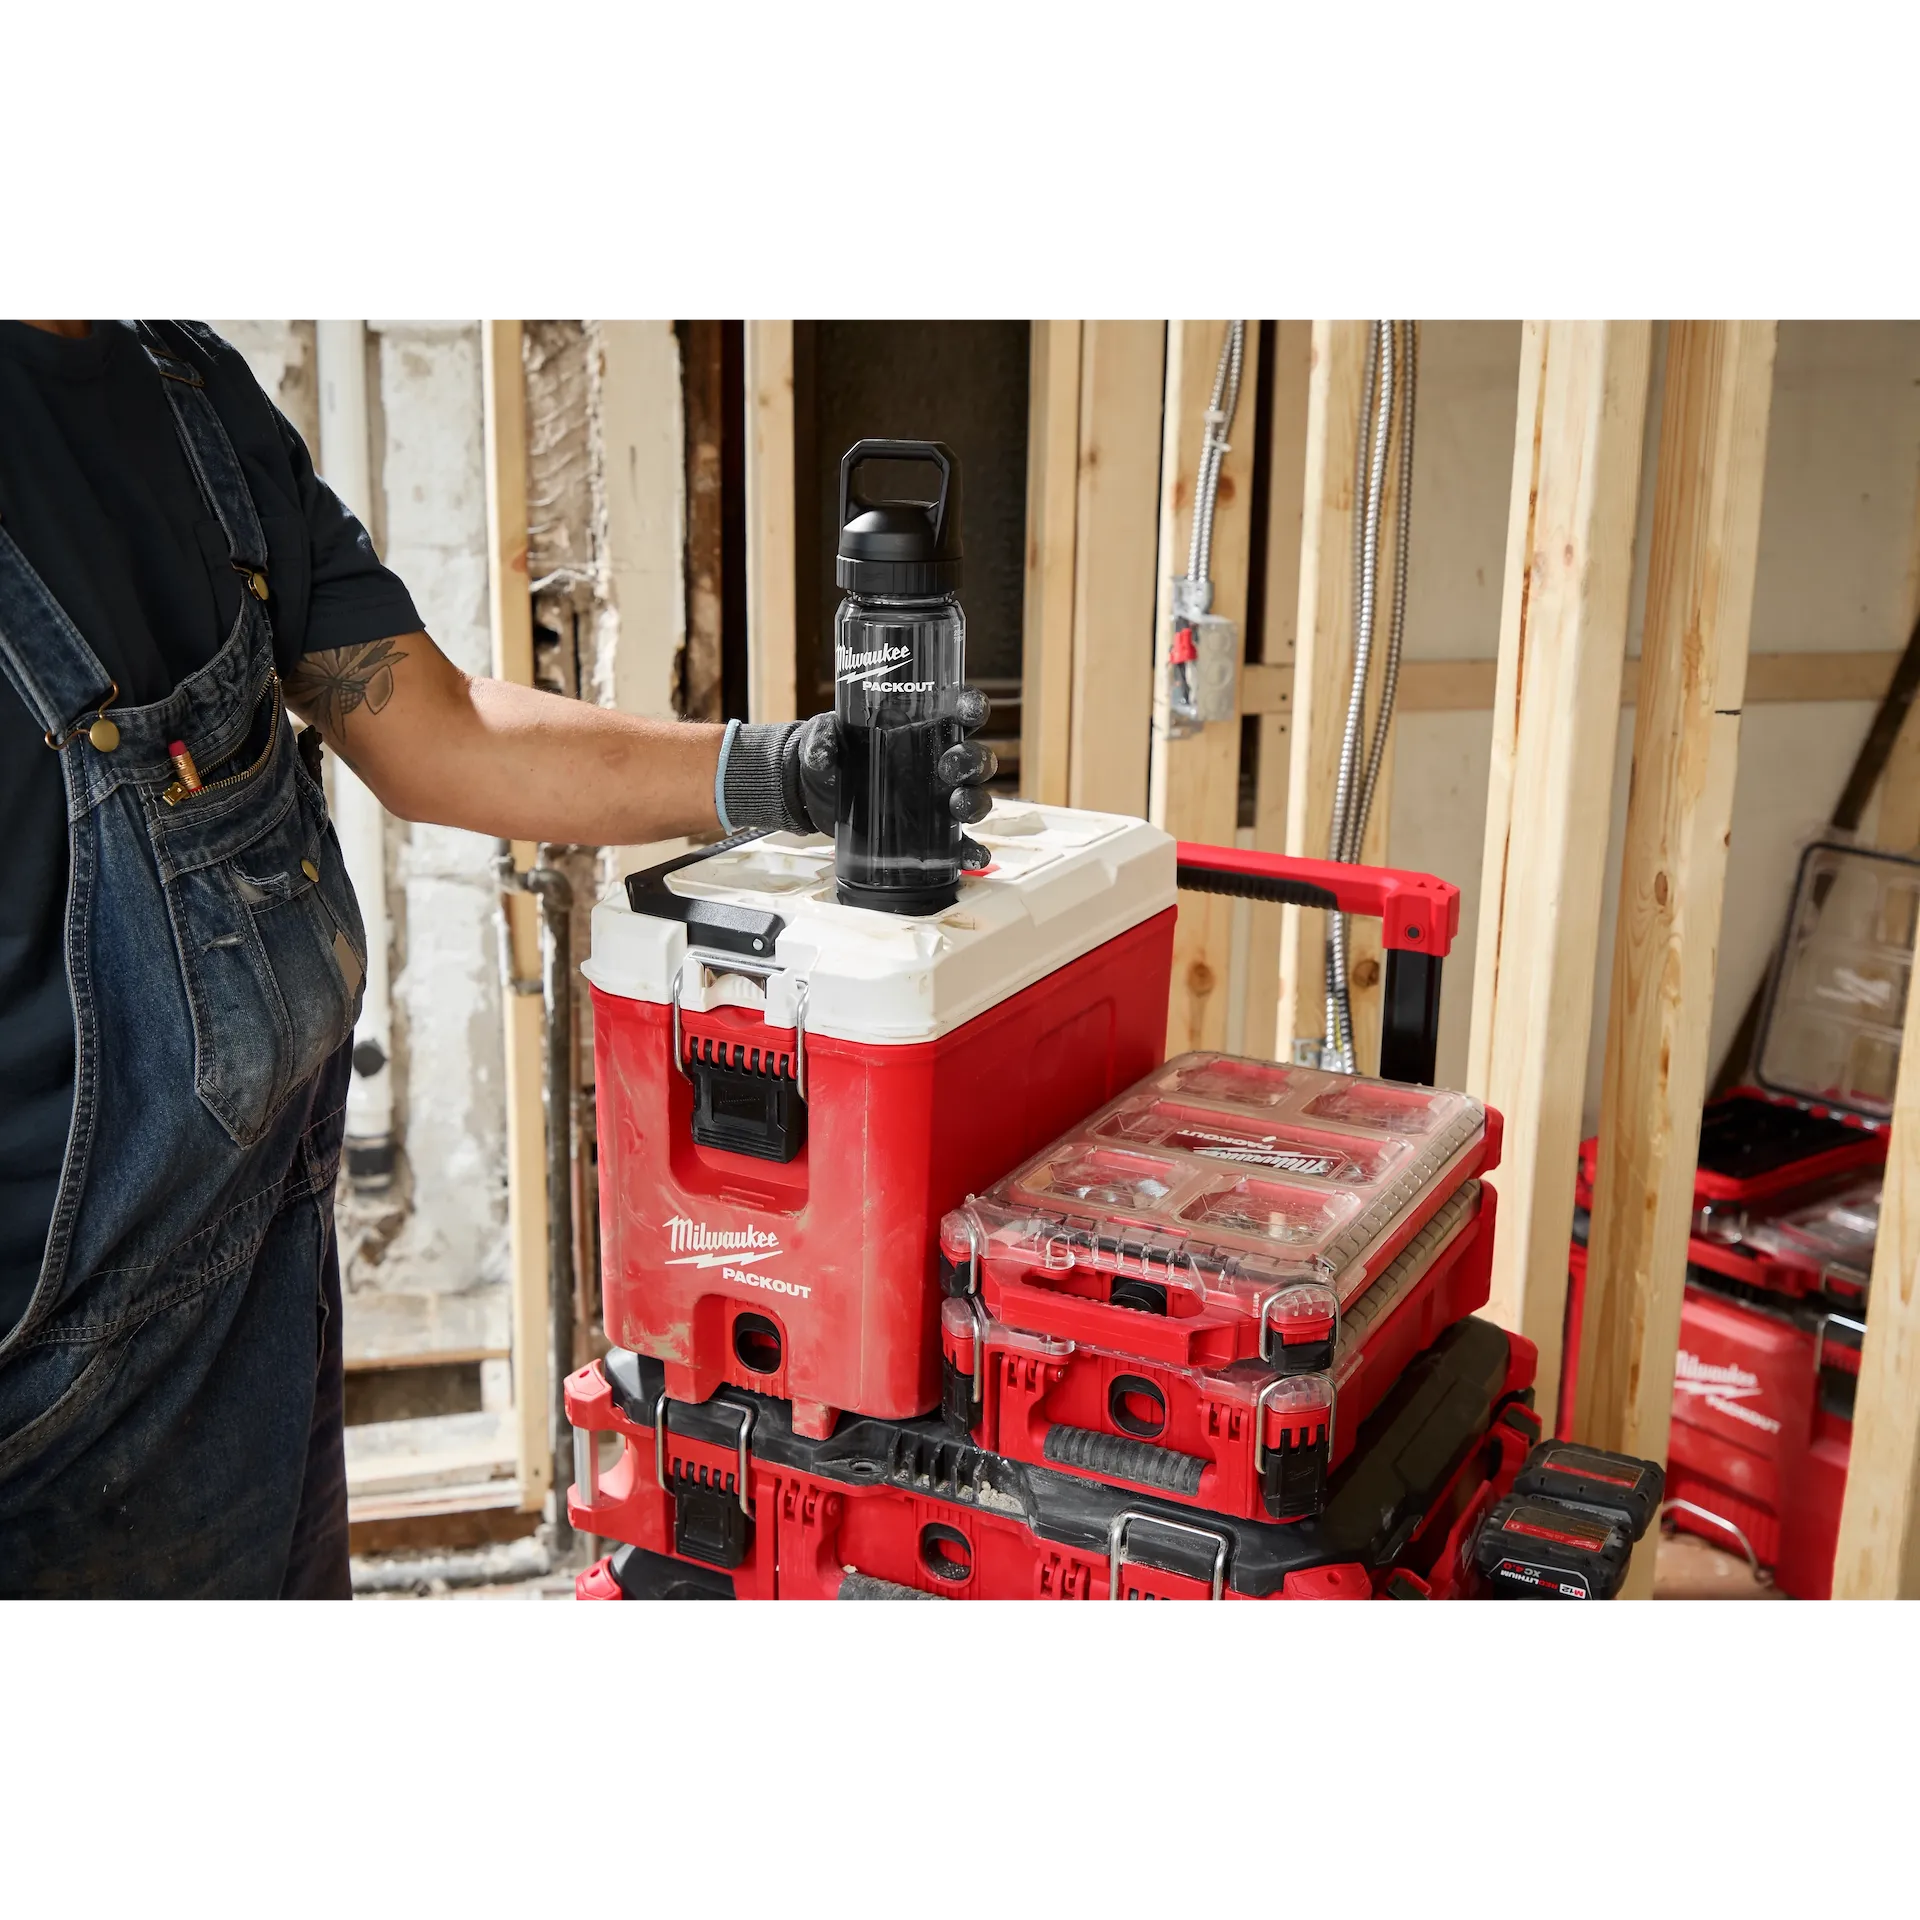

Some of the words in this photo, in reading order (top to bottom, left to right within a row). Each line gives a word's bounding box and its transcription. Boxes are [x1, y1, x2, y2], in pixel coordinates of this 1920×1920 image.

[836, 643, 911, 673] Milwaukee
[862, 681, 935, 693] PACKOUT
[1176, 1129, 1274, 1151] PACKOUT
[662, 1215, 780, 1253] Milwaukee
[722, 1267, 811, 1299] PACKOUT
[1500, 1569, 1558, 1590] REDLITHIUM
[1561, 1585, 1584, 1598] M12
